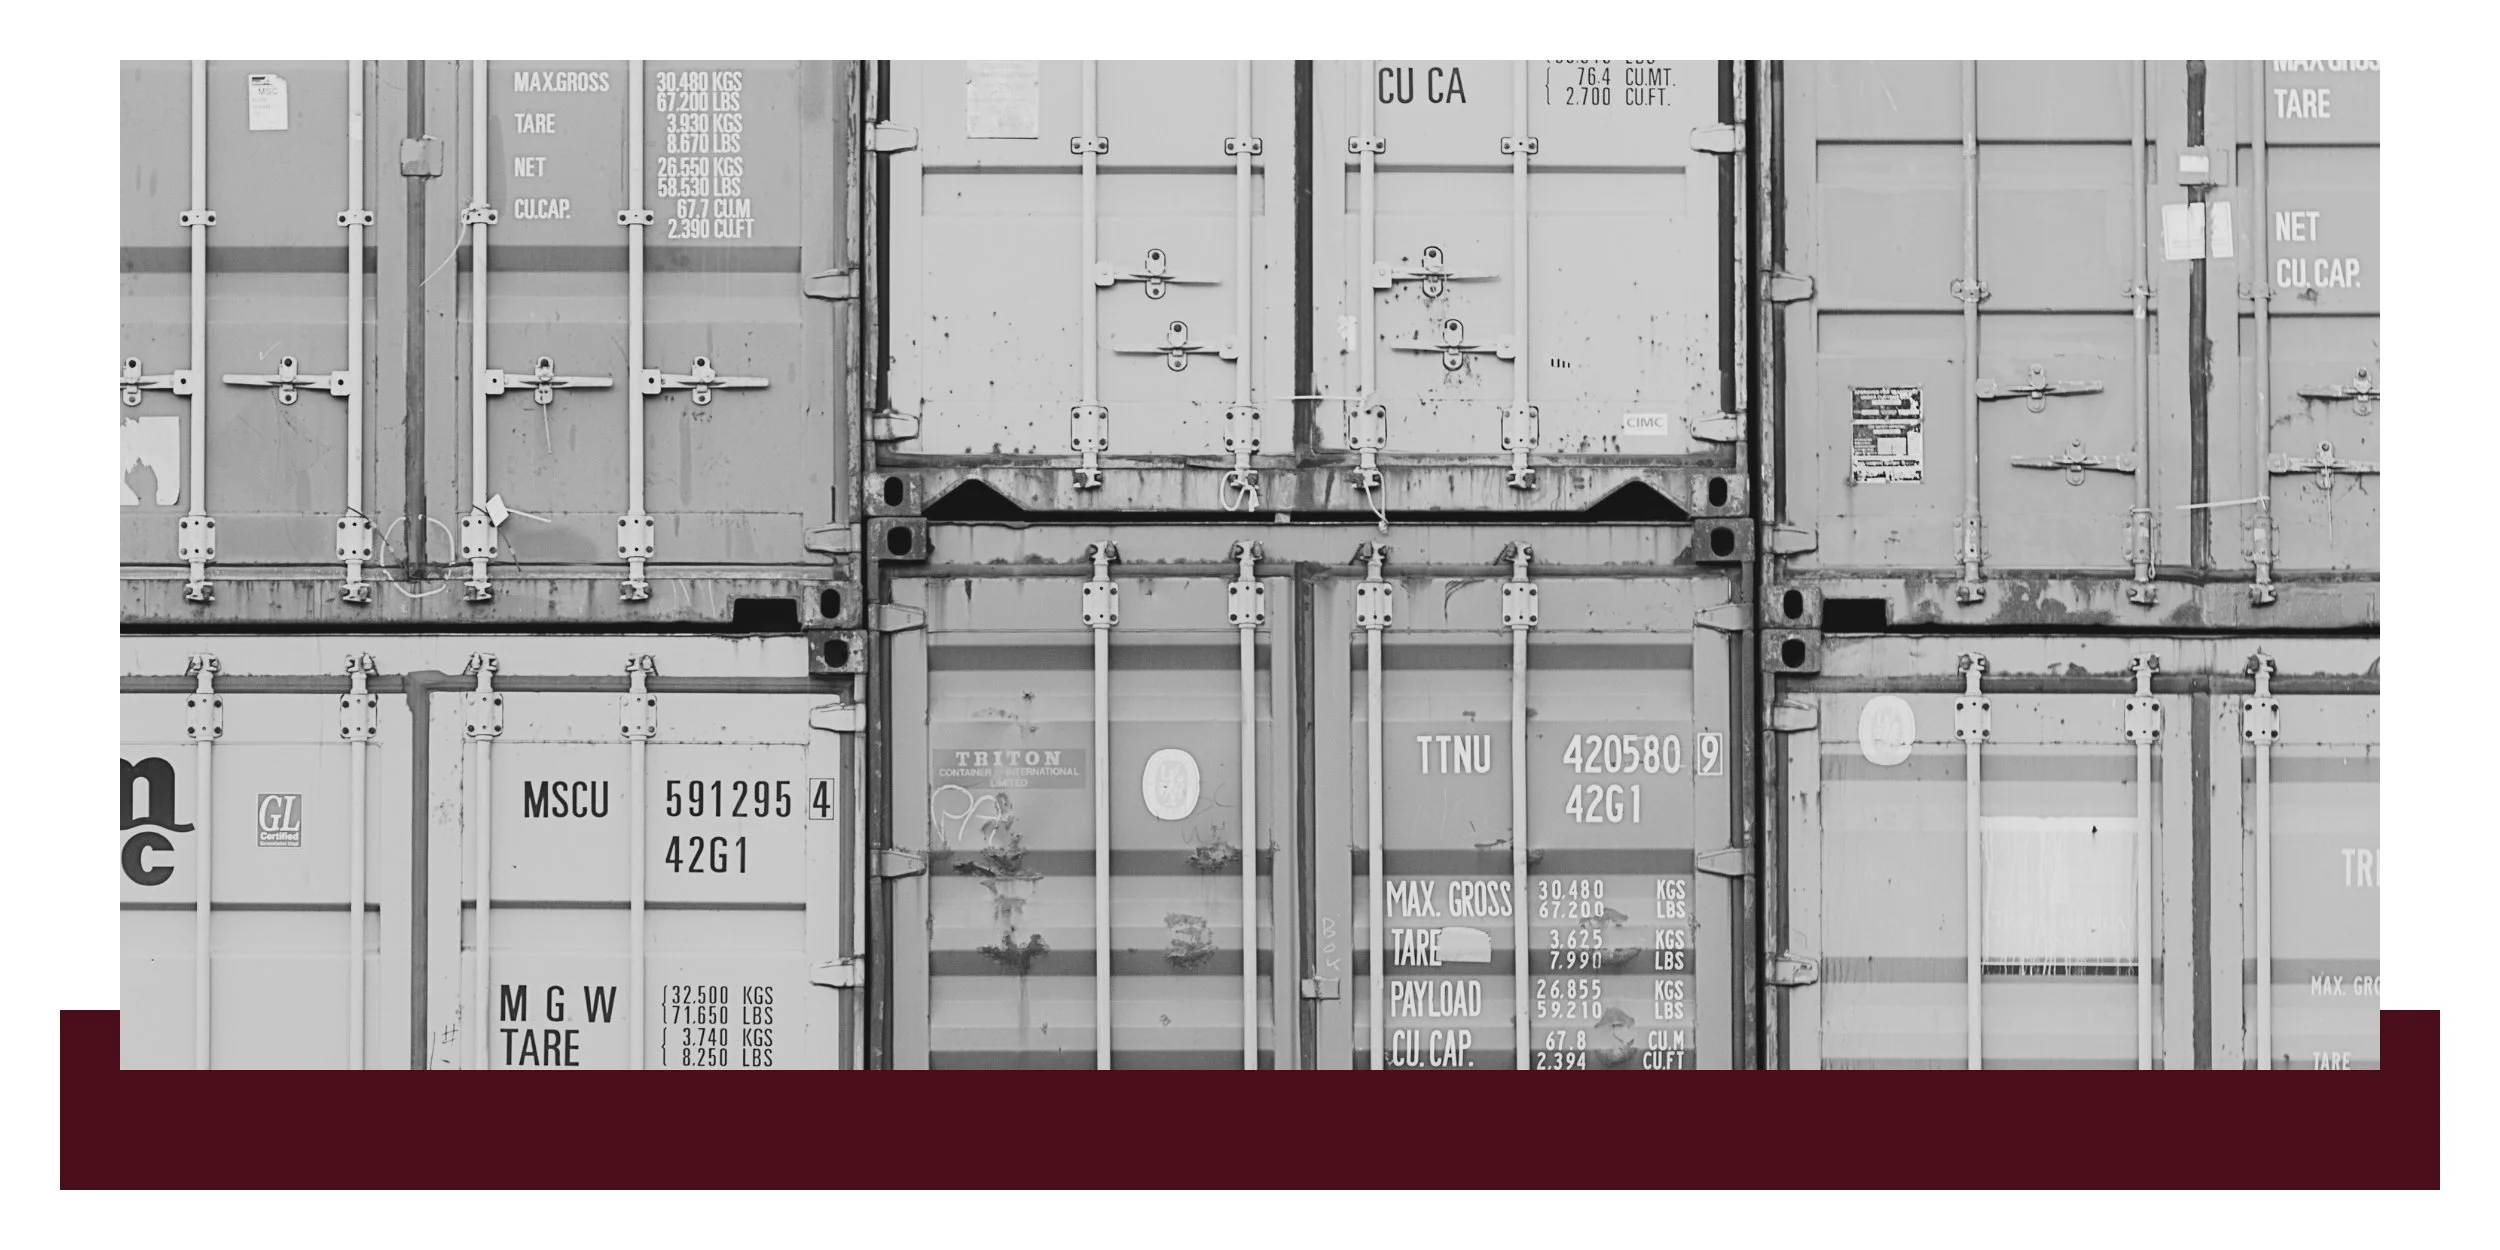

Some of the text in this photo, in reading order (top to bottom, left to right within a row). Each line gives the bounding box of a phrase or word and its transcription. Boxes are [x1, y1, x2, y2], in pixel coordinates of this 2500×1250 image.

[514, 72, 609, 92] MAX.GROSS
[657, 72, 742, 92] 30.480 KGS
[1378, 67, 1466, 104] CU CA
[1577, 68, 1676, 87] 76.4 CU.MT.
[657, 92, 740, 111] 67.200 LBS
[1566, 87, 1670, 106] 2.700 CU.FT.
[2274, 89, 2331, 118] TARE
[514, 113, 555, 133] TARE
[667, 113, 742, 133] 3.930 KGS
[667, 133, 740, 153] 8.670 LBS
[514, 157, 546, 177] NET
[658, 157, 743, 177] 26.550 KGS
[658, 177, 741, 197] 58.530 LBS
[677, 199, 750, 219] 67.7 CU.M
[668, 219, 754, 238] 2.390 CU.FT
[2275, 211, 2319, 242] NET
[1627, 417, 1663, 428] CIMC
[956, 751, 1062, 766] TRITON
[1417, 734, 1719, 774] TTNU 420580 9
[939, 767, 1079, 777] CONTAINER INTERNATIONAL
[990, 778, 1028, 787] LIMITED
[524, 780, 831, 818] MSCU 591295 4
[1565, 784, 1641, 823] 42G1
[259, 795, 300, 831] GL
[260, 832, 299, 840] Certified
[665, 836, 747, 874] 42G1
[1386, 880, 1513, 917] MAX. GROSS
[1538, 880, 1686, 900] 30.480 KGS
[1539, 901, 1686, 918] 67.200 LBS
[1391, 929, 1442, 966] TARE
[1550, 929, 1684, 950] 3.625 KGS
[1550, 951, 1684, 970] 7.990 LBS
[672, 985, 773, 1004] 32.500 KGS
[1537, 979, 1684, 1001] 26.855 KGS
[2311, 975, 2346, 996] MAX.
[500, 985, 616, 1023] M G W
[1391, 980, 1481, 1017] PAYLOAD
[672, 1006, 773, 1024] 71.650 LBS
[1537, 1001, 1684, 1019] 59.210 LBS
[500, 1028, 580, 1067] TARE
[683, 1028, 773, 1047] 3.740 KGS
[1648, 1031, 1684, 1050] CU.M
[683, 1048, 772, 1067] 8.250 LBS
[1643, 1051, 1684, 1070] CU.FT
[2313, 1052, 2351, 1070] TARE
